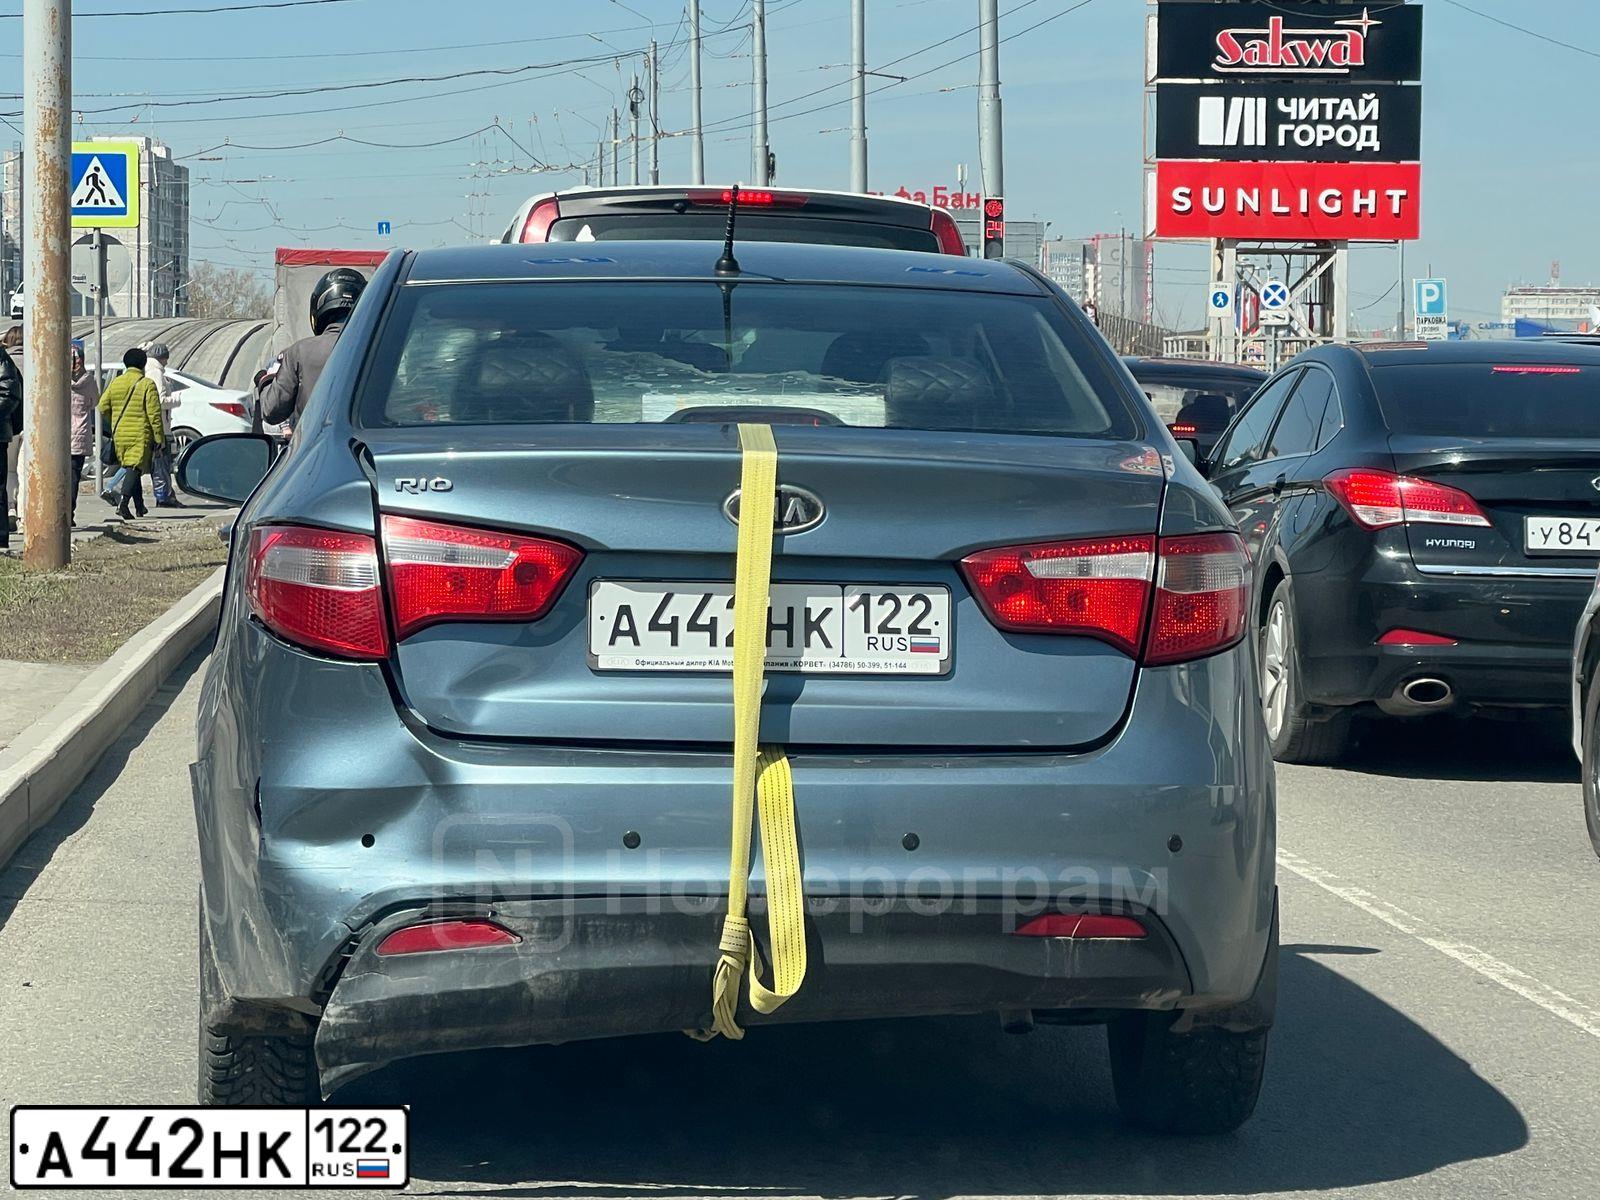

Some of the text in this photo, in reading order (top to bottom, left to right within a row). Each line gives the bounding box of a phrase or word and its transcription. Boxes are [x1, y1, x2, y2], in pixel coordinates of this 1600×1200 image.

[1214, 16, 1366, 67] Sakwa
[1277, 93, 1380, 121] ЧИТАЙ
[1278, 124, 1381, 151] ГОРОД
[932, 186, 981, 208] Бан
[1171, 186, 1408, 215] SUNLIGHT
[986, 220, 1003, 239] 24
[1416, 316, 1447, 325] ПАРКОВКА
[394, 476, 454, 495] RIO
[1425, 538, 1476, 549] HYUNDAI
[608, 591, 834, 649] А44НК
[849, 592, 932, 635] 122
[866, 636, 908, 652] RUS
[635, 659, 685, 668] Официальный
[686, 660, 707, 668] дилер
